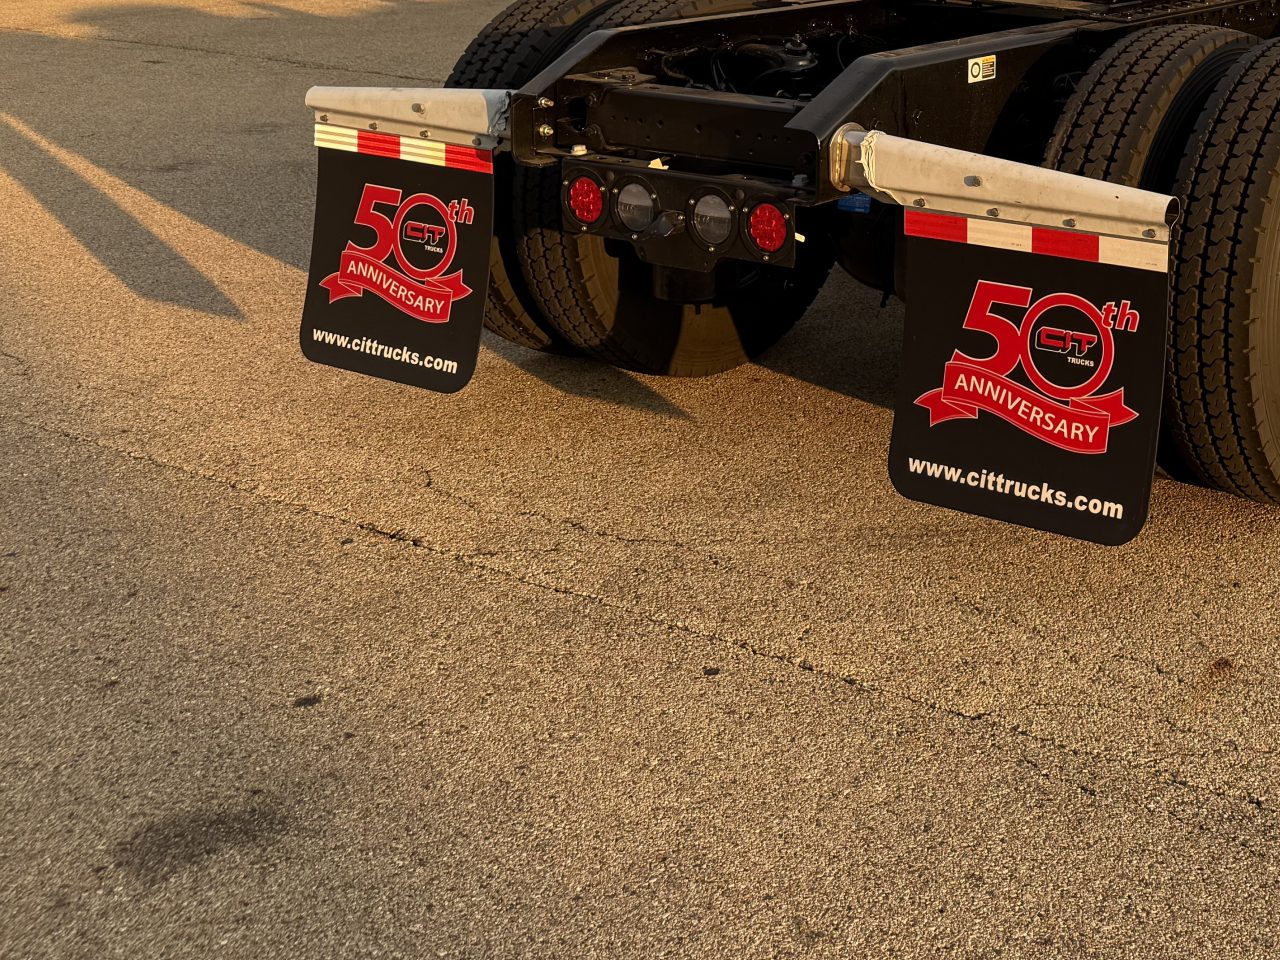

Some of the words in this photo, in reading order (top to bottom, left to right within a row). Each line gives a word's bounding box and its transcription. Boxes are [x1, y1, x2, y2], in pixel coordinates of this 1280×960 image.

[402, 220, 446, 246] CIT
[424, 244, 444, 254] TRUCKS
[347, 260, 445, 315] ANNIVERSARY
[313, 327, 458, 374] www.cittrucks.com
[1035, 326, 1098, 356] CIT
[1067, 356, 1094, 367] TRUCKS
[955, 373, 1099, 443] ANNIVERSARY
[909, 457, 1124, 520] www.cittrucks.com
